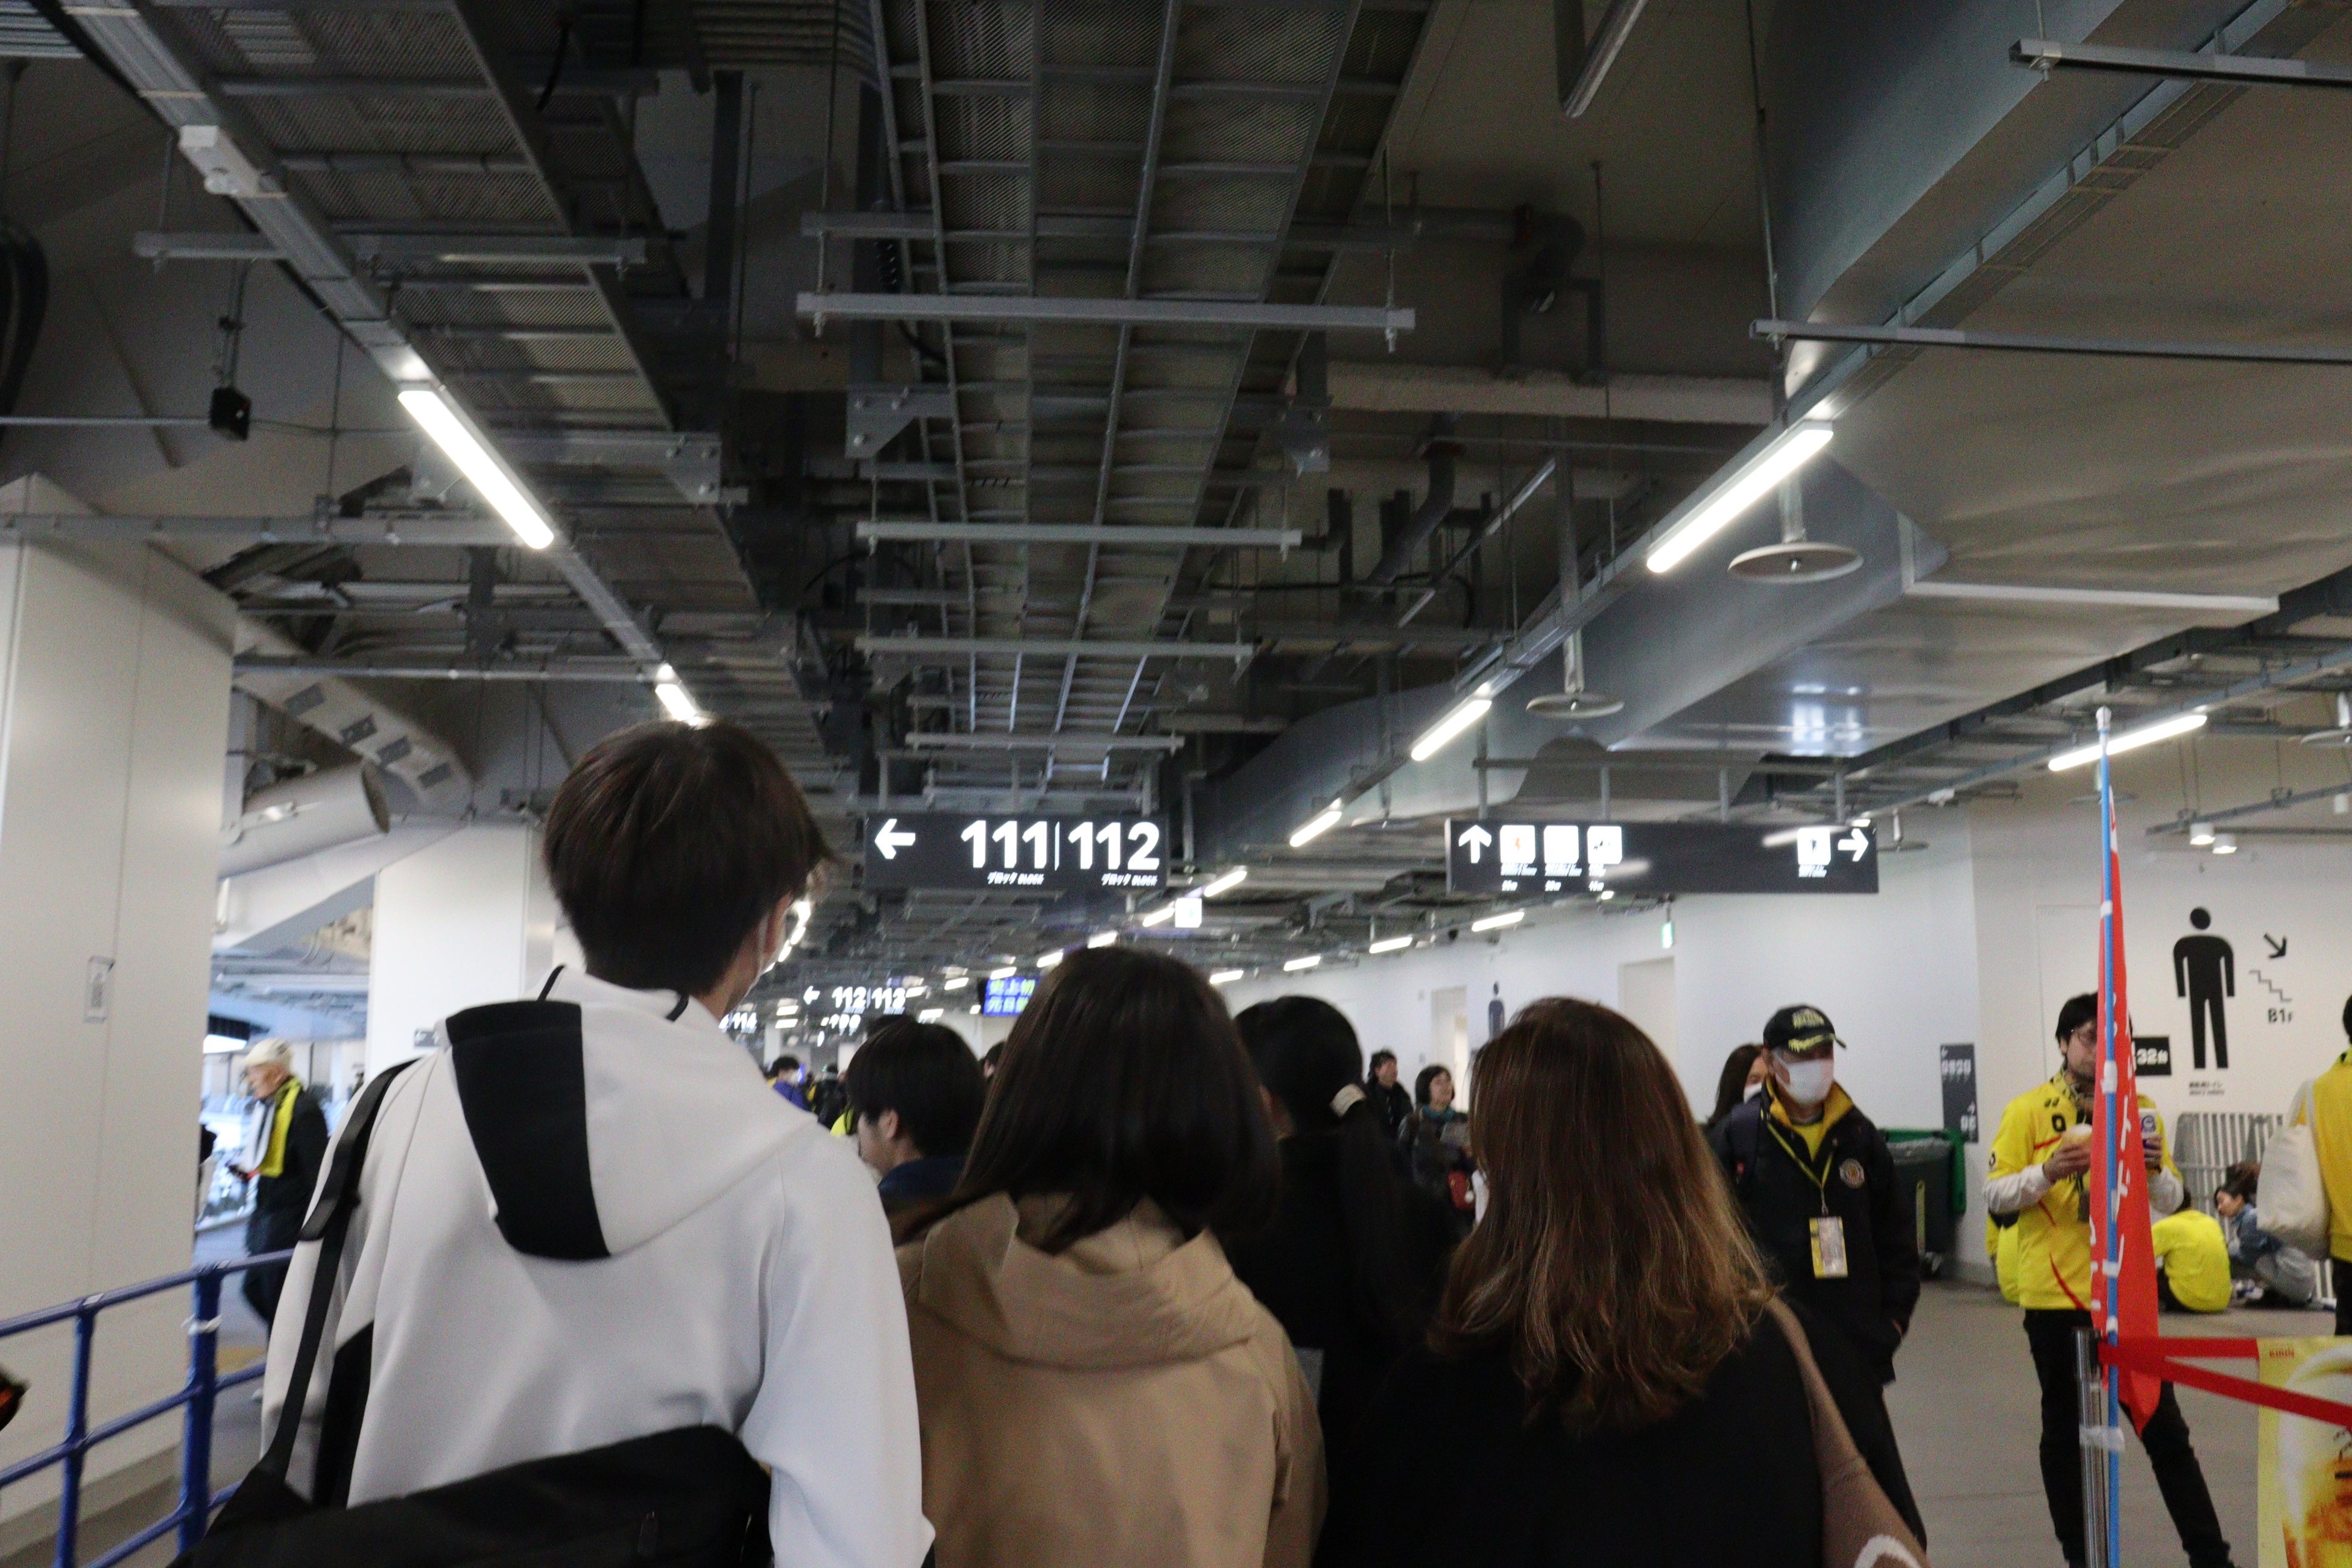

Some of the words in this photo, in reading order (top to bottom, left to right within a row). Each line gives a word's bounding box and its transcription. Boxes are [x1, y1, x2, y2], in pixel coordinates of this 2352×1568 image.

[960, 820, 1048, 869] 111
[1067, 821, 1160, 870] 112
[832, 986, 867, 1008] 112
[871, 987, 906, 1009] 113
